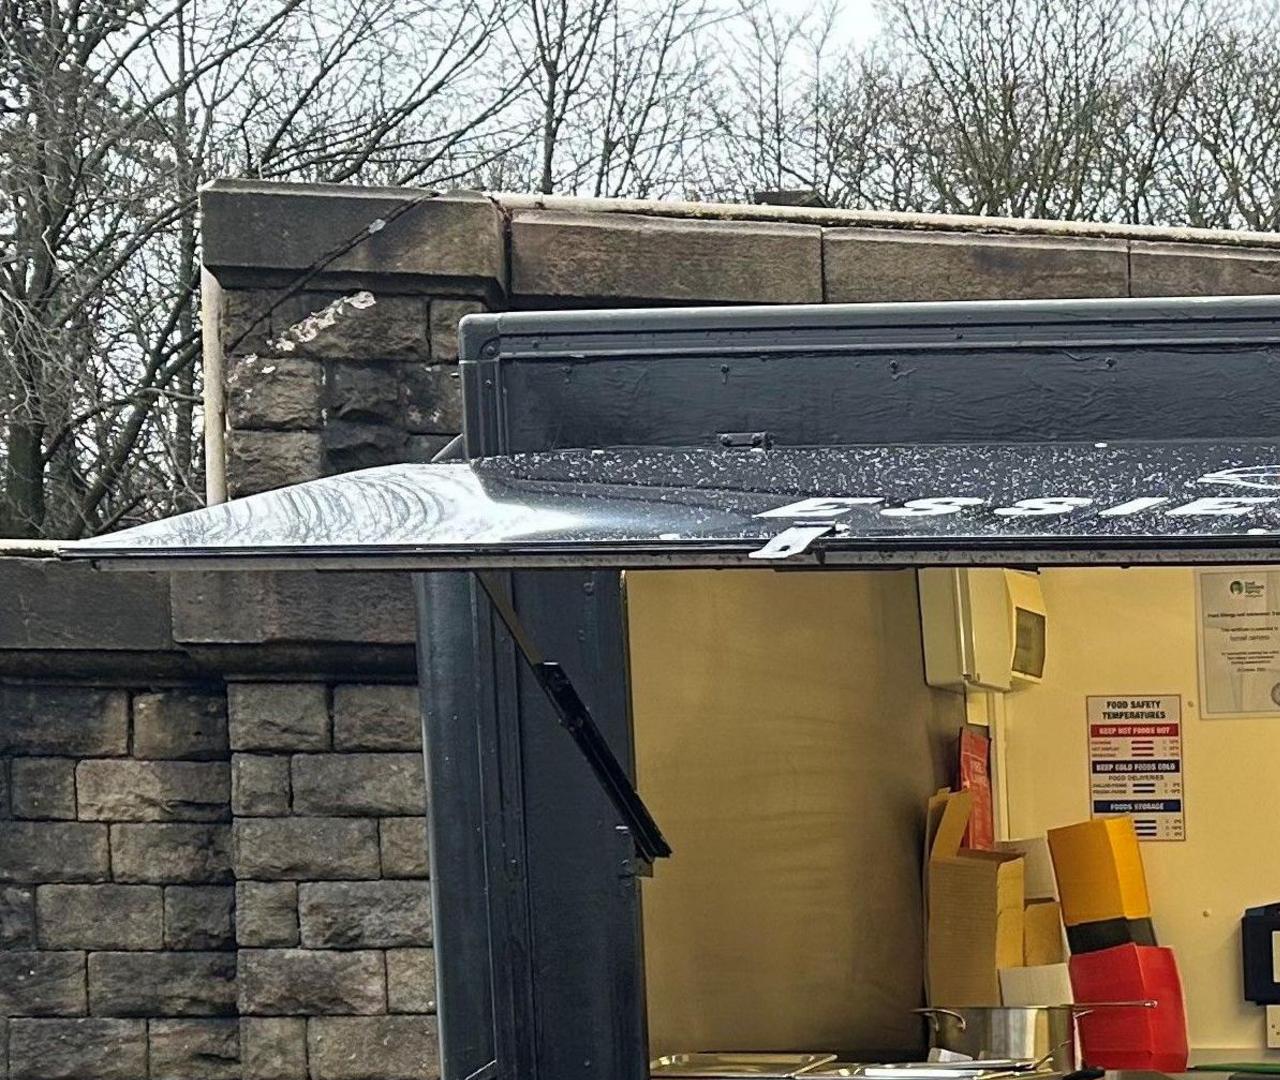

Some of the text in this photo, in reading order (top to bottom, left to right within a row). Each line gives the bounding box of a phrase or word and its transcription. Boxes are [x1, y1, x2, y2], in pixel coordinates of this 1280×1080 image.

[751, 496, 1278, 518] ESSIE
[1107, 700, 1160, 709] FOOD SAFETY
